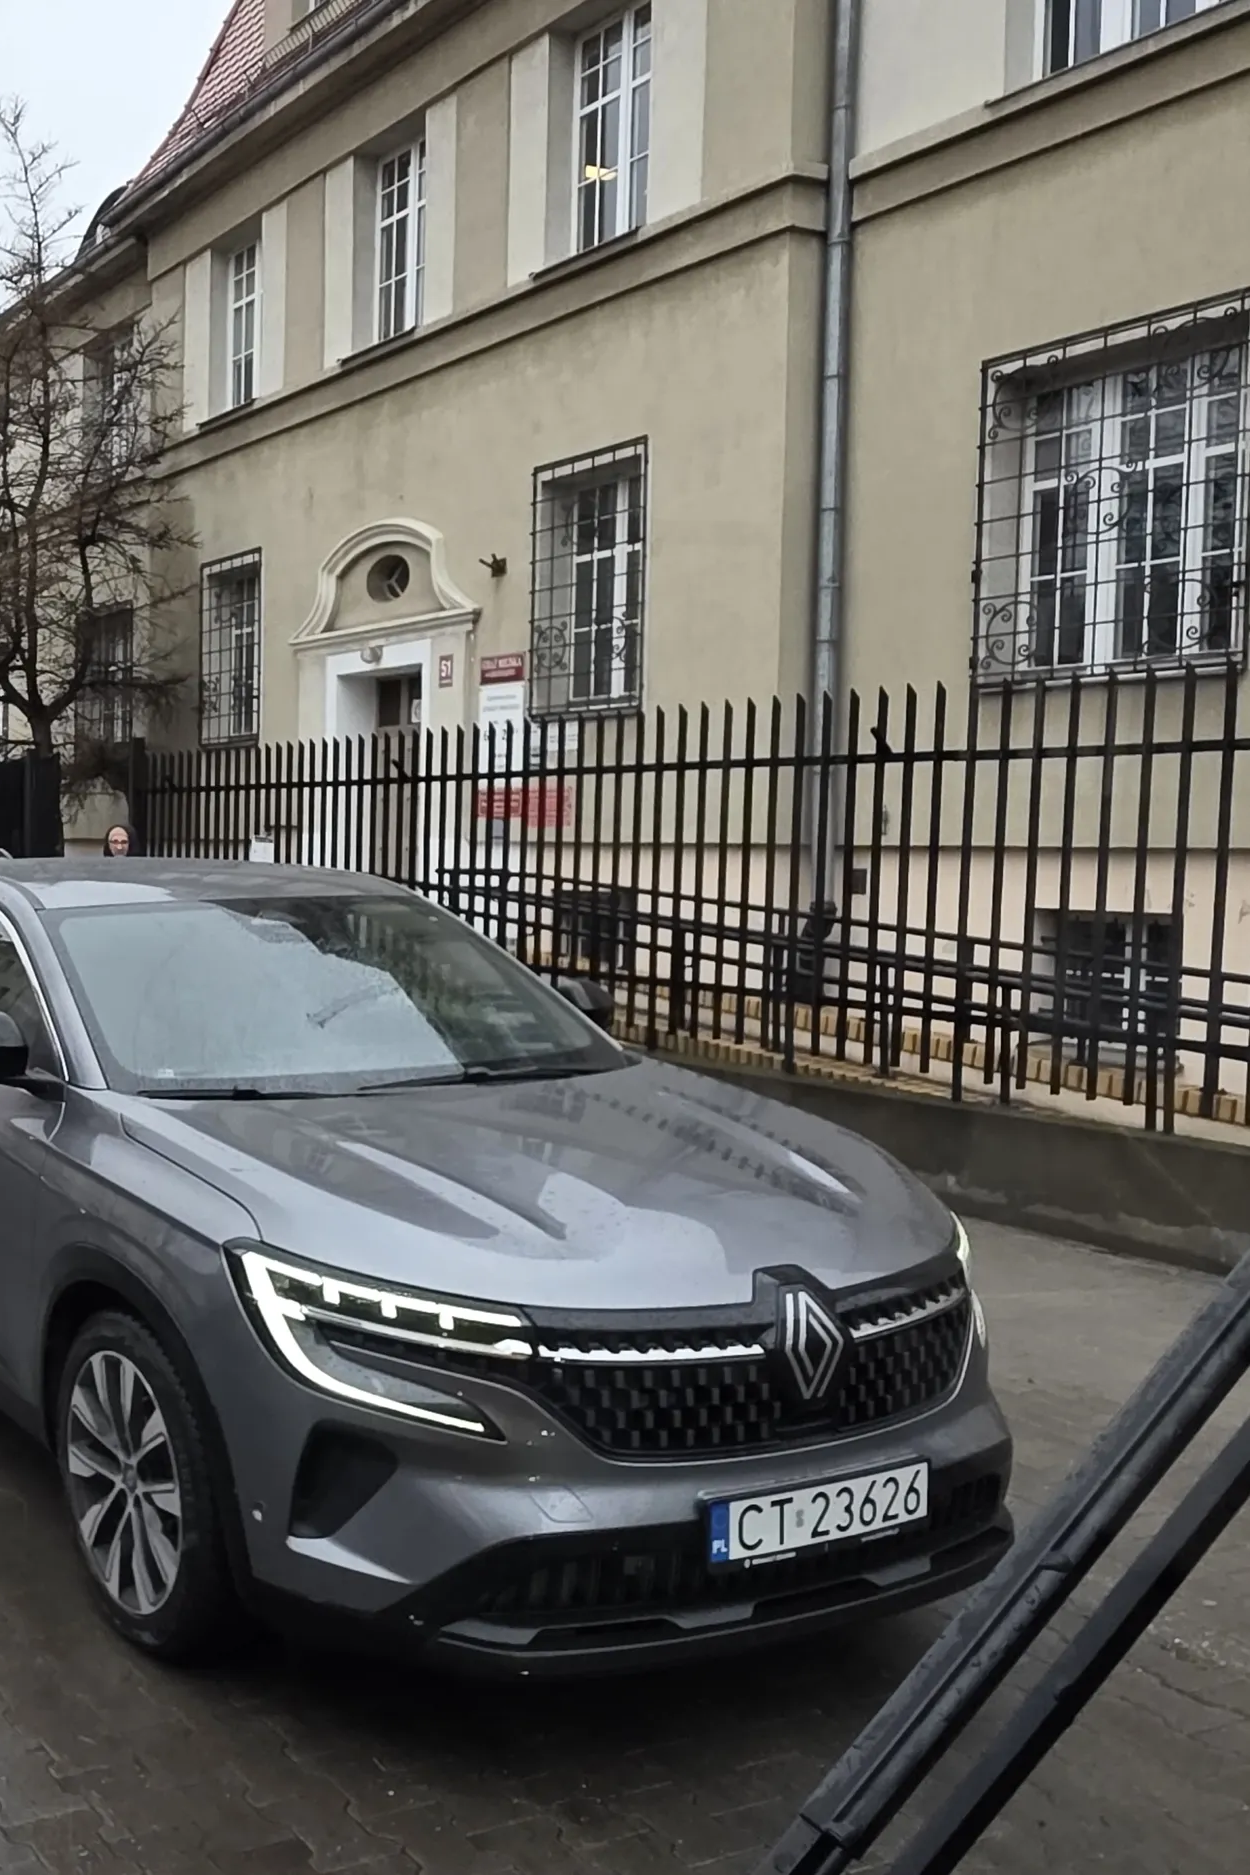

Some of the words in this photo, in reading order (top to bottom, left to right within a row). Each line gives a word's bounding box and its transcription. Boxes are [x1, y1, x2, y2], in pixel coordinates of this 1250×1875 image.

[737, 1496, 794, 1551] CT
[810, 1469, 921, 1539] 23626
[711, 1539, 728, 1554] PL
